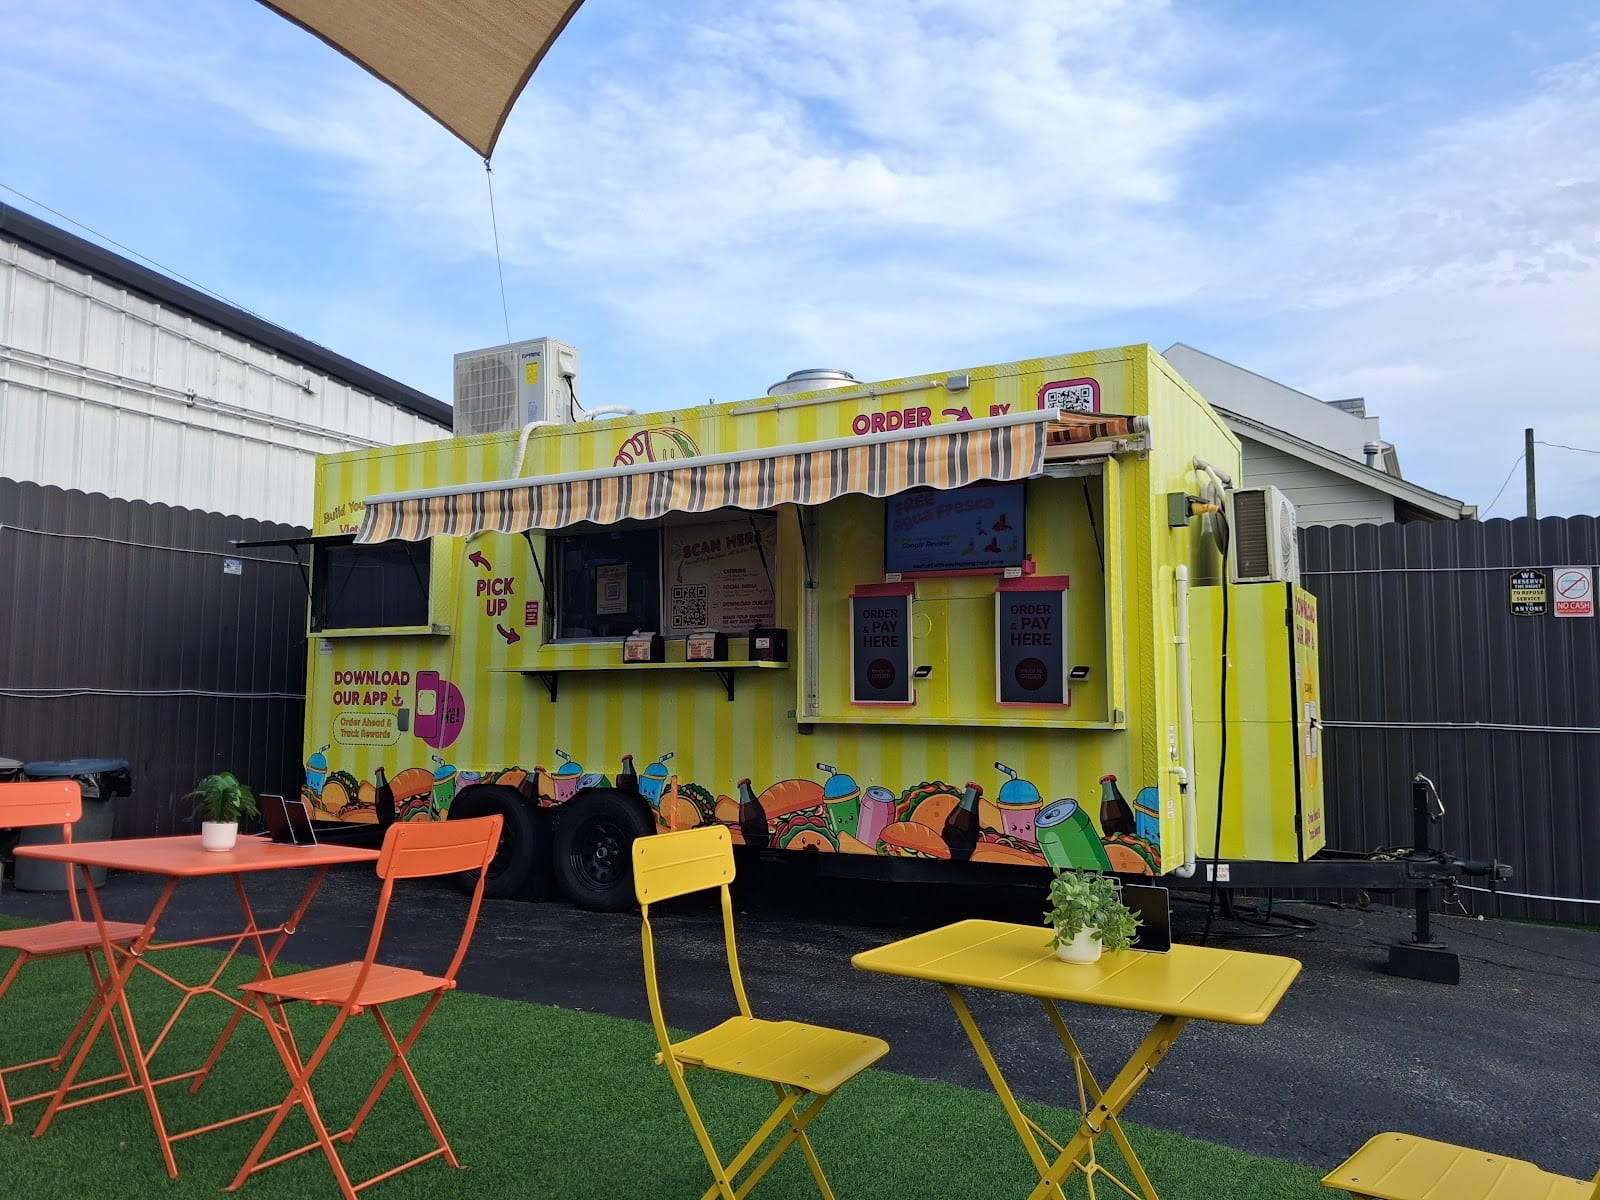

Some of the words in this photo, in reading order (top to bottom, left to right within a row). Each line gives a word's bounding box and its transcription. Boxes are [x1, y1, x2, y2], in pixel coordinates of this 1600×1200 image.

[852, 406, 932, 435] ORDER
[894, 494, 935, 515] FREE
[323, 503, 346, 525] Build
[348, 501, 366, 514] You
[683, 538, 722, 559] SCAN
[476, 577, 515, 597] PICK
[486, 599, 508, 617] UP
[862, 608, 898, 619] ORDER
[1010, 604, 1051, 615] ORDER
[872, 621, 898, 633] PAY
[1021, 617, 1051, 630] PAY
[863, 635, 899, 648] HERE
[1011, 632, 1052, 646] HERE
[333, 670, 411, 686] DOWNLOAD
[332, 690, 360, 706] OUR
[363, 690, 389, 706] APP
[340, 717, 361, 727] Order
[361, 717, 385, 727] Ahead
[340, 728, 360, 738] Track
[360, 729, 391, 738] Rewards
